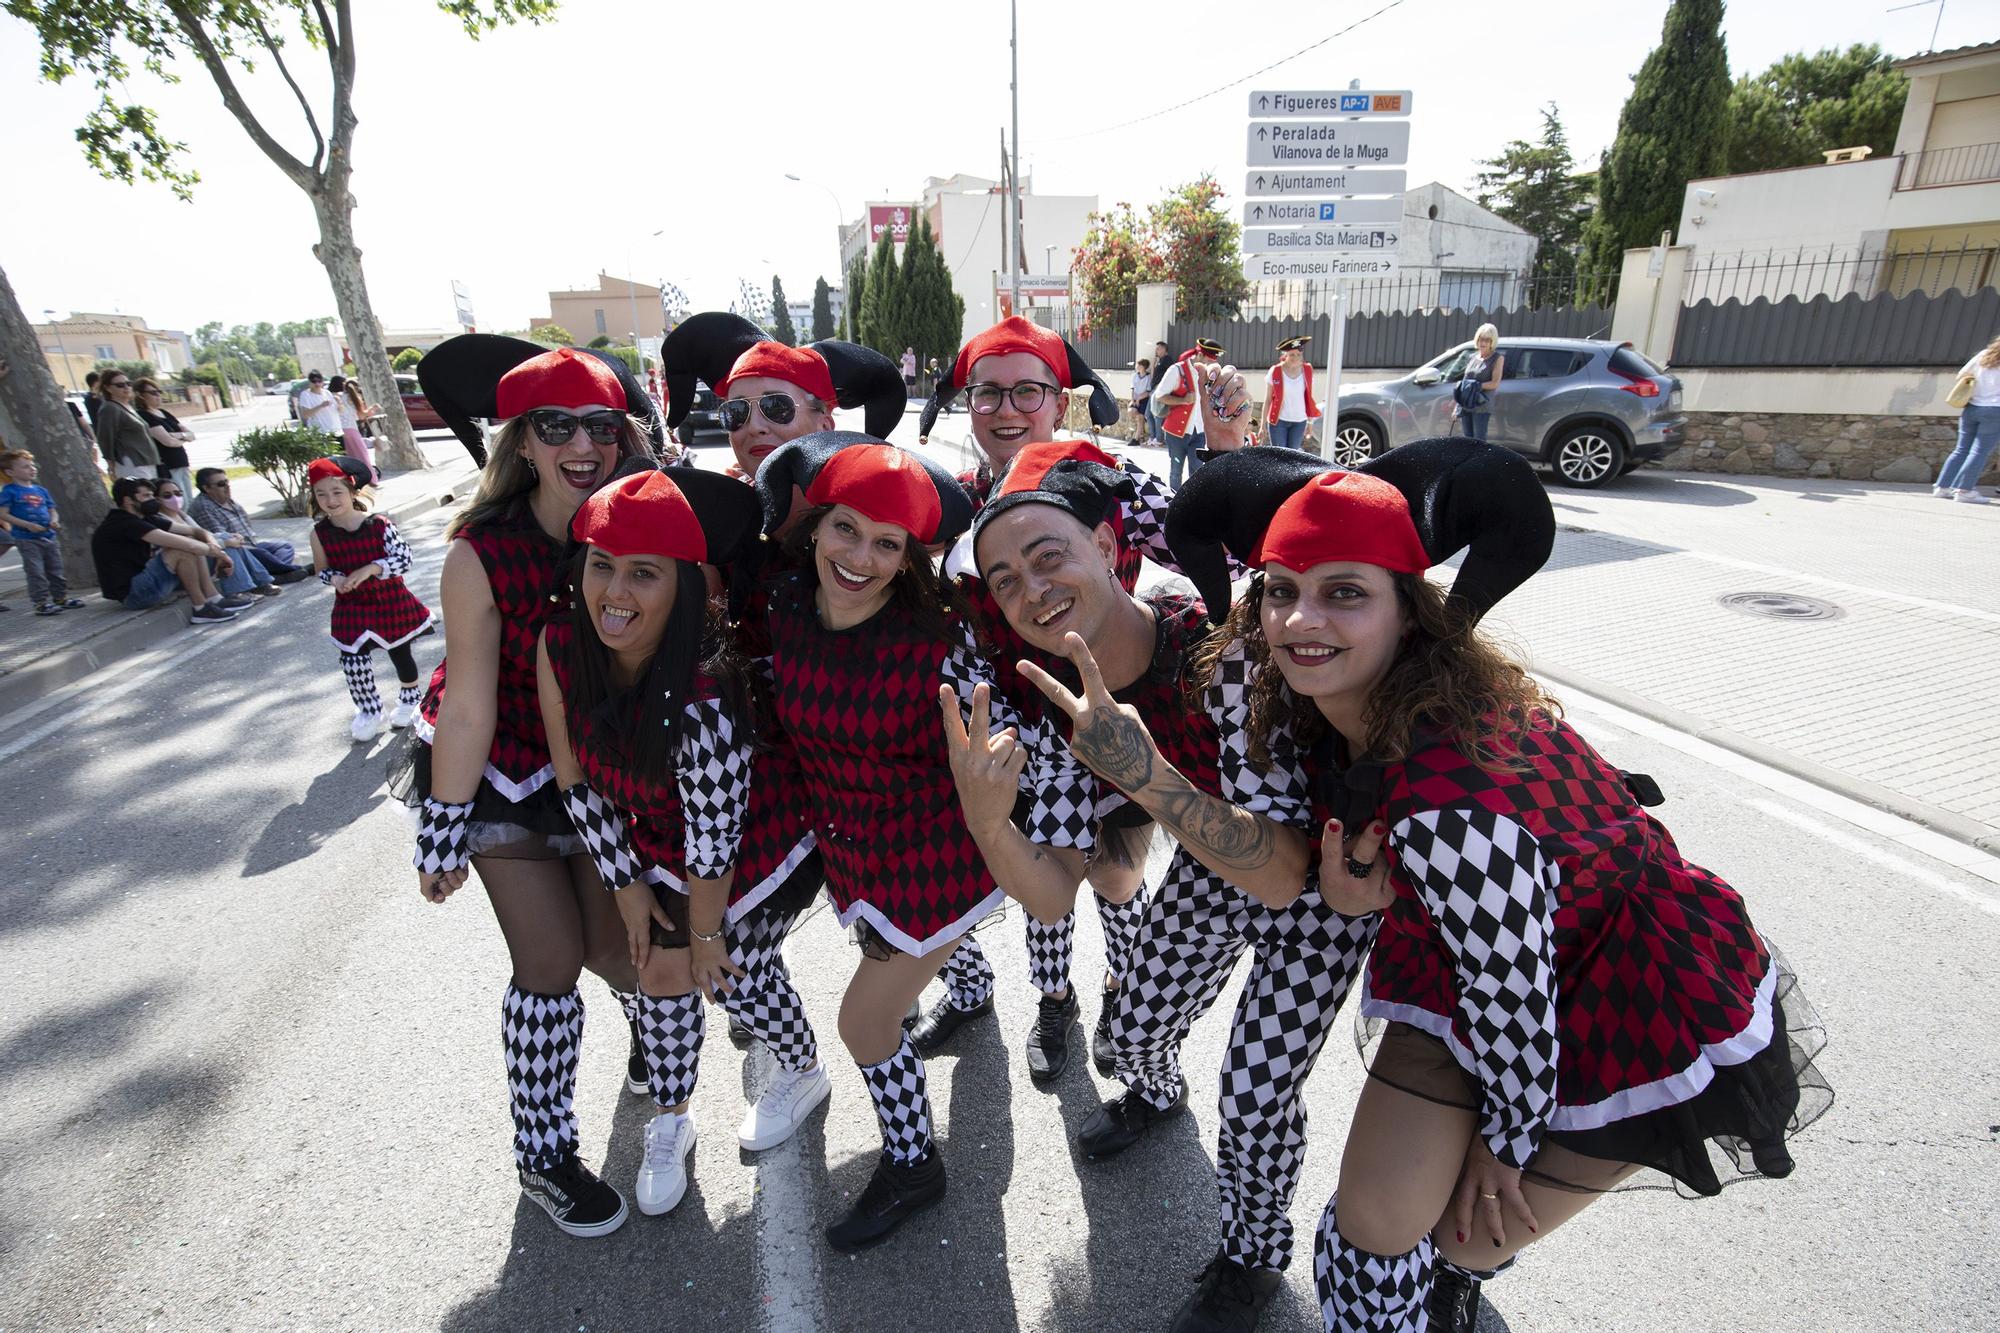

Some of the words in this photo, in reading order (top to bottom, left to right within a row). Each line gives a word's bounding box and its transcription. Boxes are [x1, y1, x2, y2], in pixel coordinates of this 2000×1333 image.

[1274, 95, 1337, 112] Figueres
[1343, 97, 1367, 110] AP-7
[1375, 97, 1400, 109] AVE
[1272, 126, 1336, 141] Peralada
[1272, 145, 1322, 159] Vilanova
[1326, 145, 1340, 158] de
[1343, 145, 1354, 158] la
[1357, 144, 1389, 161] Muga
[1271, 174, 1346, 192] Ajuntament
[1268, 204, 1315, 219] Notaria
[1315, 231, 1334, 246] Sta
[1337, 231, 1369, 246] Maria
[1263, 260, 1328, 275] Eco-museu
[1332, 259, 1378, 273] Farinera
